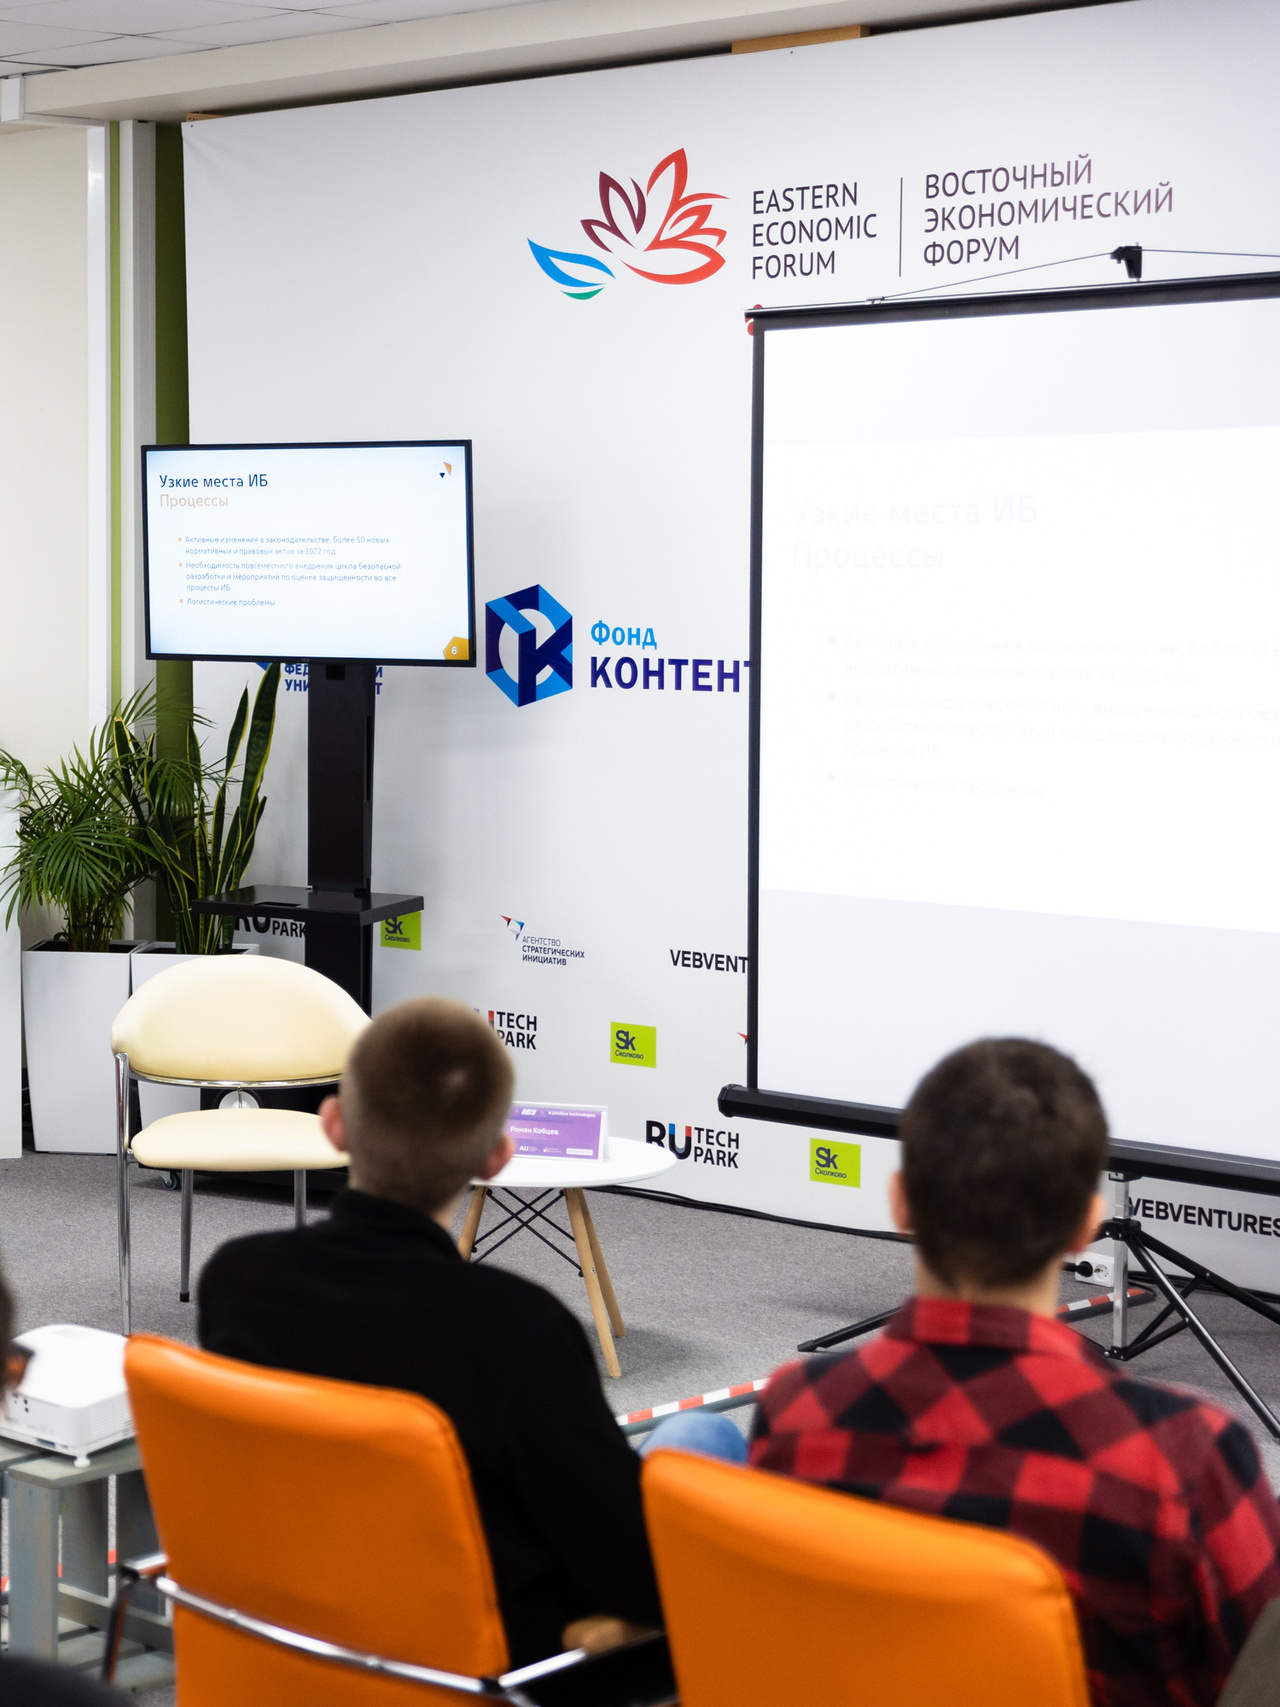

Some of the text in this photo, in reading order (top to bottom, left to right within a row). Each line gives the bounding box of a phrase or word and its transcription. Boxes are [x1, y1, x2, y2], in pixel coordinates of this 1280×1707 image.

[925, 153, 1092, 199] ВОСТОЧНЫЙ
[753, 182, 857, 214] EASTERN
[924, 181, 1173, 233] ЭКОНОМИЧЕСКИЙ
[753, 214, 877, 247] ECONOMIC
[923, 235, 1019, 266] ФОРУМ
[753, 251, 835, 279] FORUM
[159, 474, 268, 488] Узкие места ИБ
[160, 494, 228, 509] Процессы
[186, 562, 240, 570] Необходимость
[590, 620, 657, 650] Фонд
[451, 645, 458, 655] 6
[590, 656, 750, 692] КОНТЕН
[384, 917, 403, 935] Sk
[384, 934, 410, 943] Сколково
[522, 936, 561, 947] АГЕНТСТВО
[522, 945, 585, 958] СТРАТЕГИЧЕСКИХ
[522, 954, 567, 966] ИНИЦИАТИВ
[496, 1011, 537, 1031] TECH
[615, 1030, 636, 1051] Sk
[614, 1049, 644, 1060] Сколково
[510, 1126, 559, 1136] Роман Кобцев
[694, 1126, 739, 1149] TECH
[694, 1146, 738, 1168] PARK
[815, 1146, 838, 1170] Sk
[814, 1167, 847, 1179] Сколково
